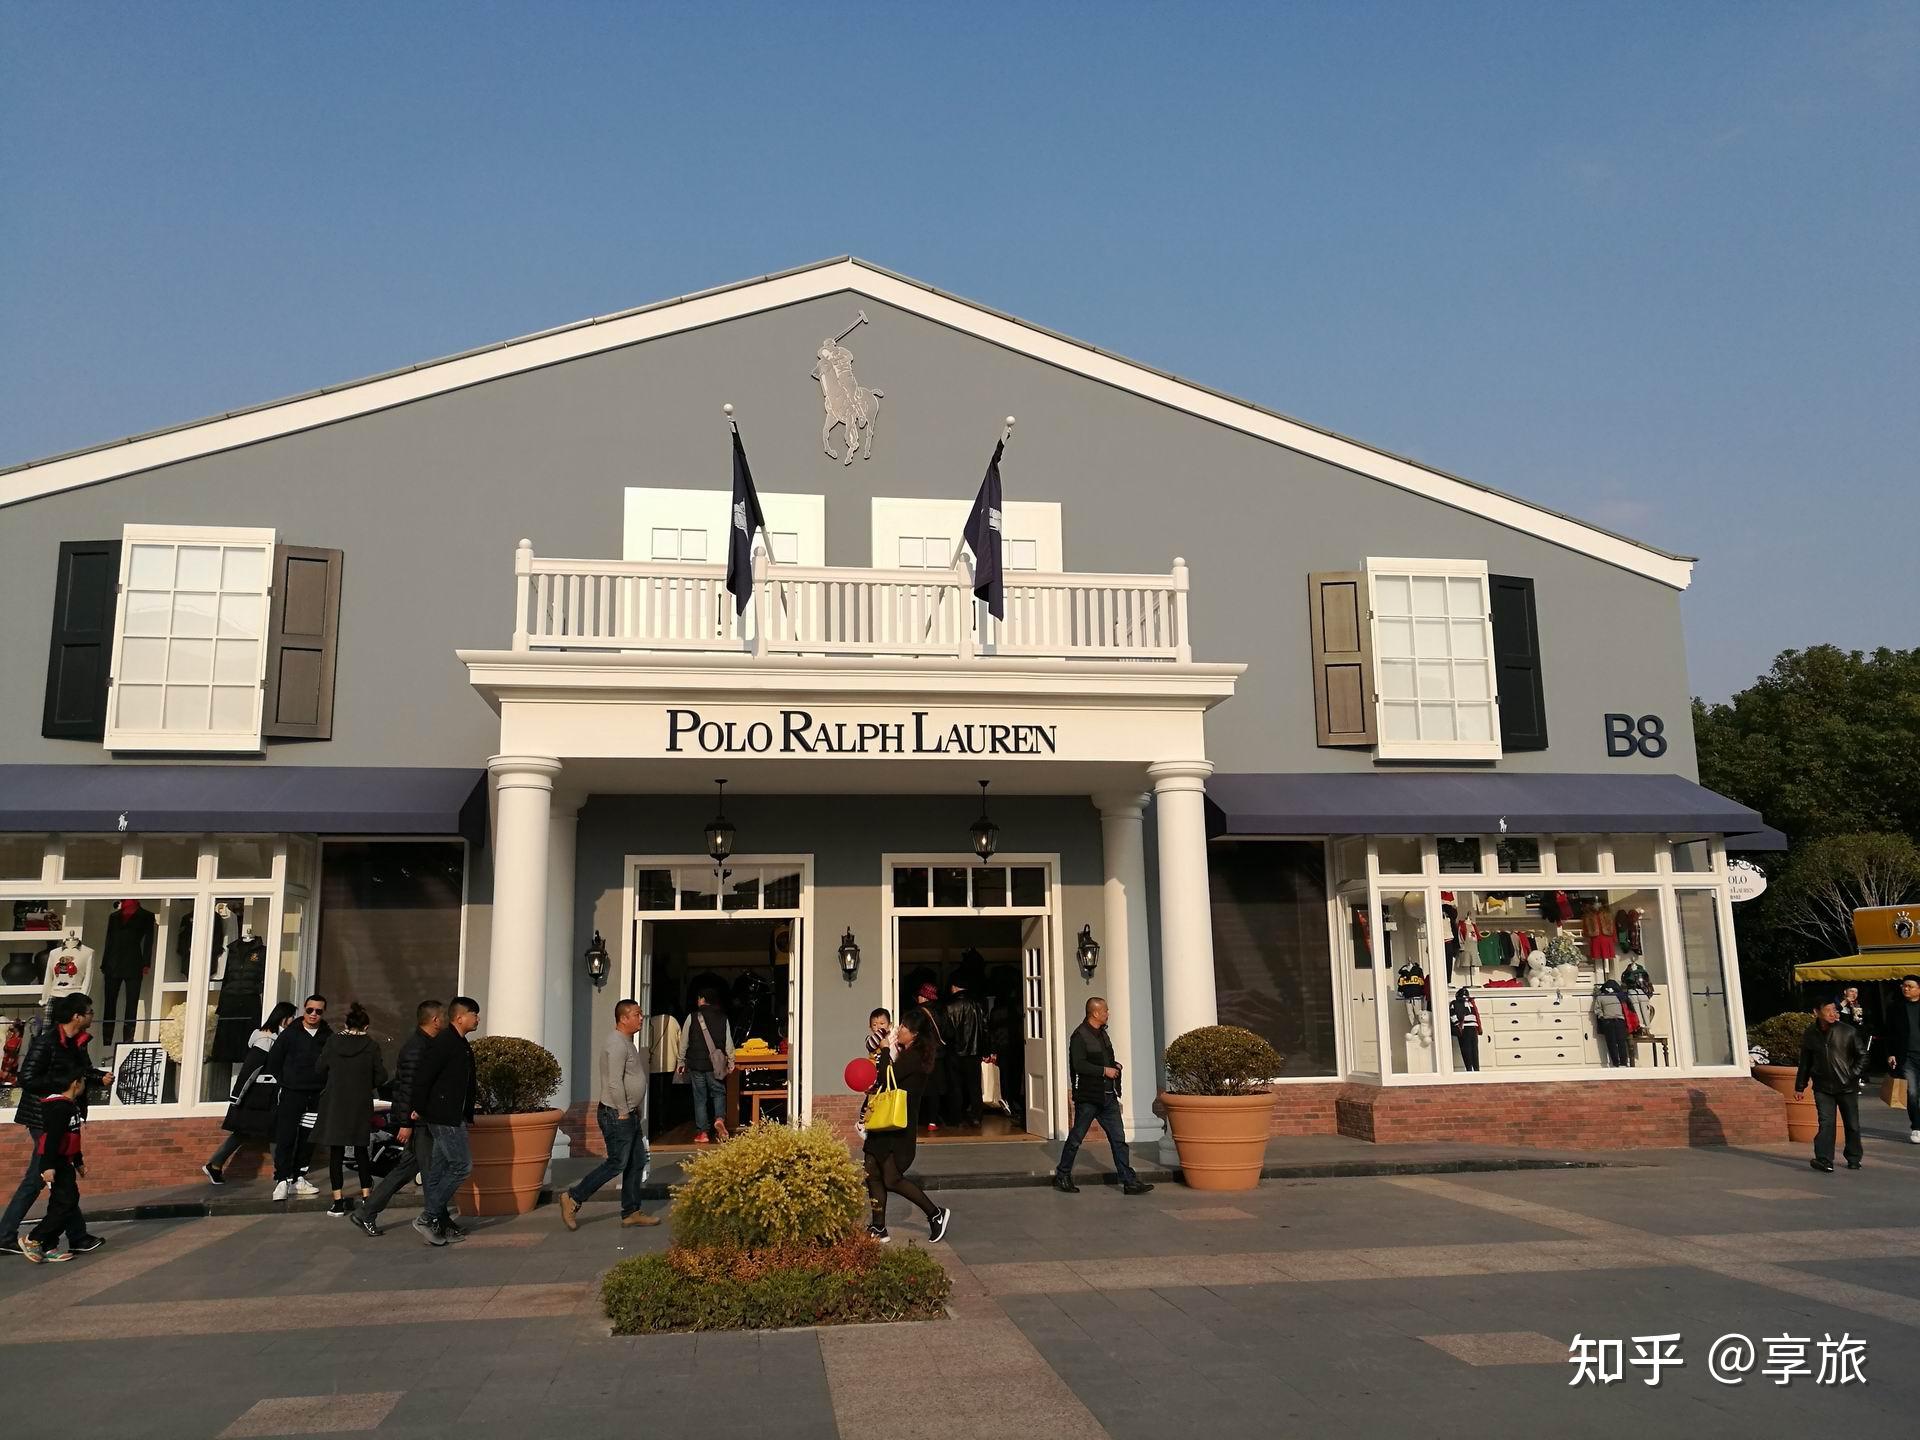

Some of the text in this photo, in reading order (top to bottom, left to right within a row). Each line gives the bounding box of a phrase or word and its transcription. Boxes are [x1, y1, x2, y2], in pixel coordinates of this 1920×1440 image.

[666, 709, 1057, 754] POLO RALPH LAUREN
[1604, 713, 1668, 758] B8
[1728, 875, 1748, 884] OLO
